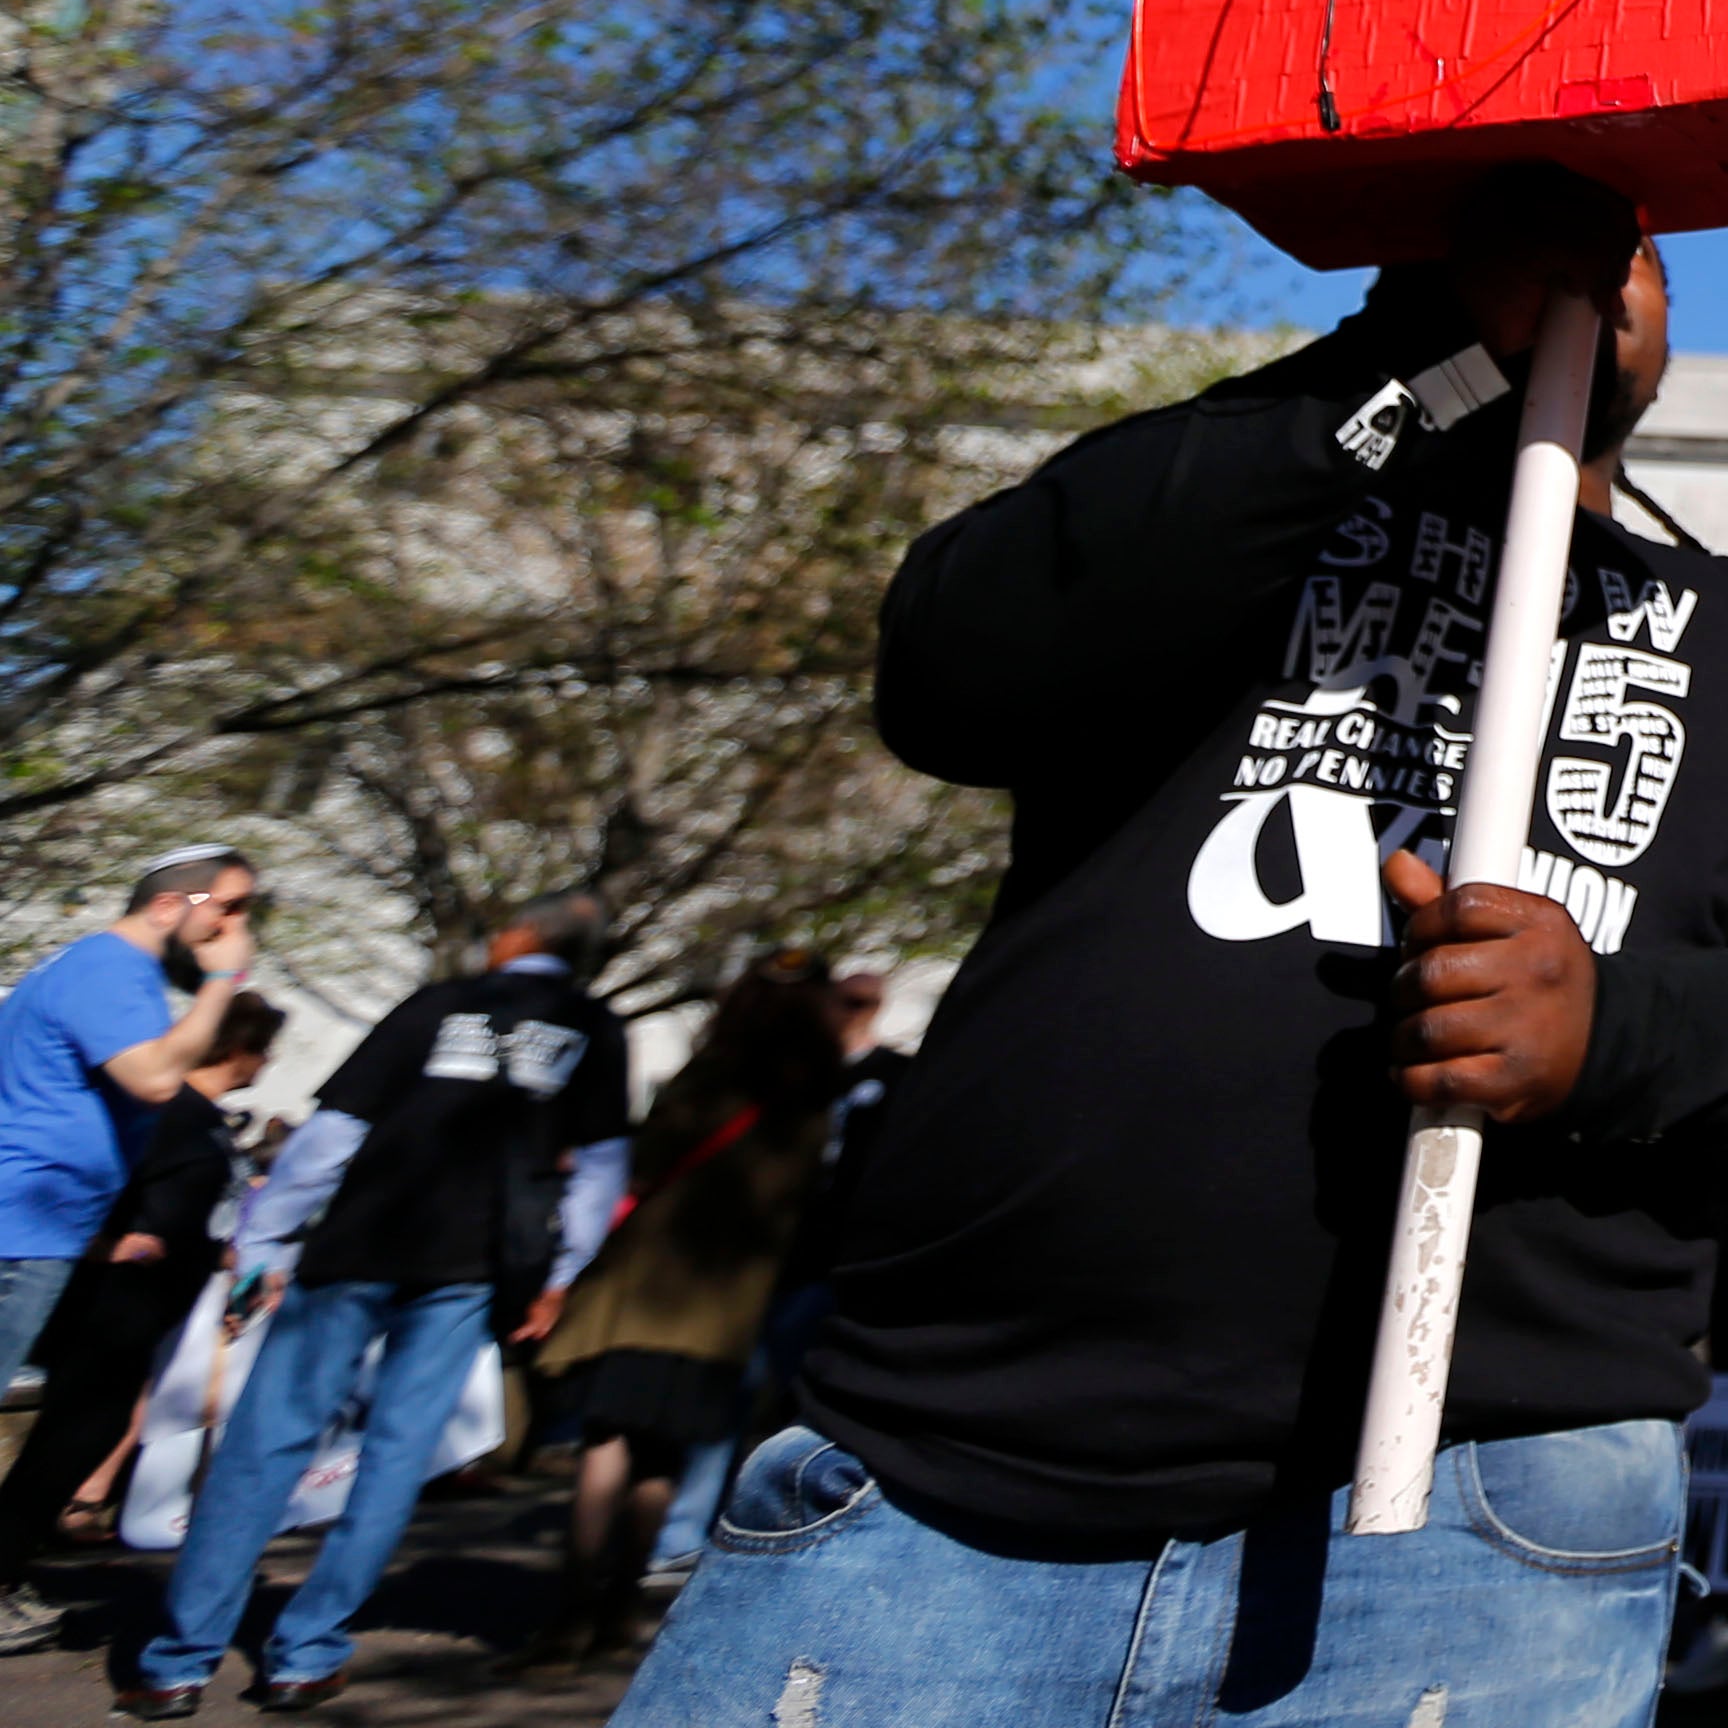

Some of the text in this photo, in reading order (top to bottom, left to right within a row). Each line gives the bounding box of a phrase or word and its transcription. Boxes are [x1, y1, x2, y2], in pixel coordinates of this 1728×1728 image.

[1316, 495, 1700, 654] SHW
[1248, 710, 1469, 771] REAL CHANGE
[1233, 748, 1455, 803] NO PENNIES
